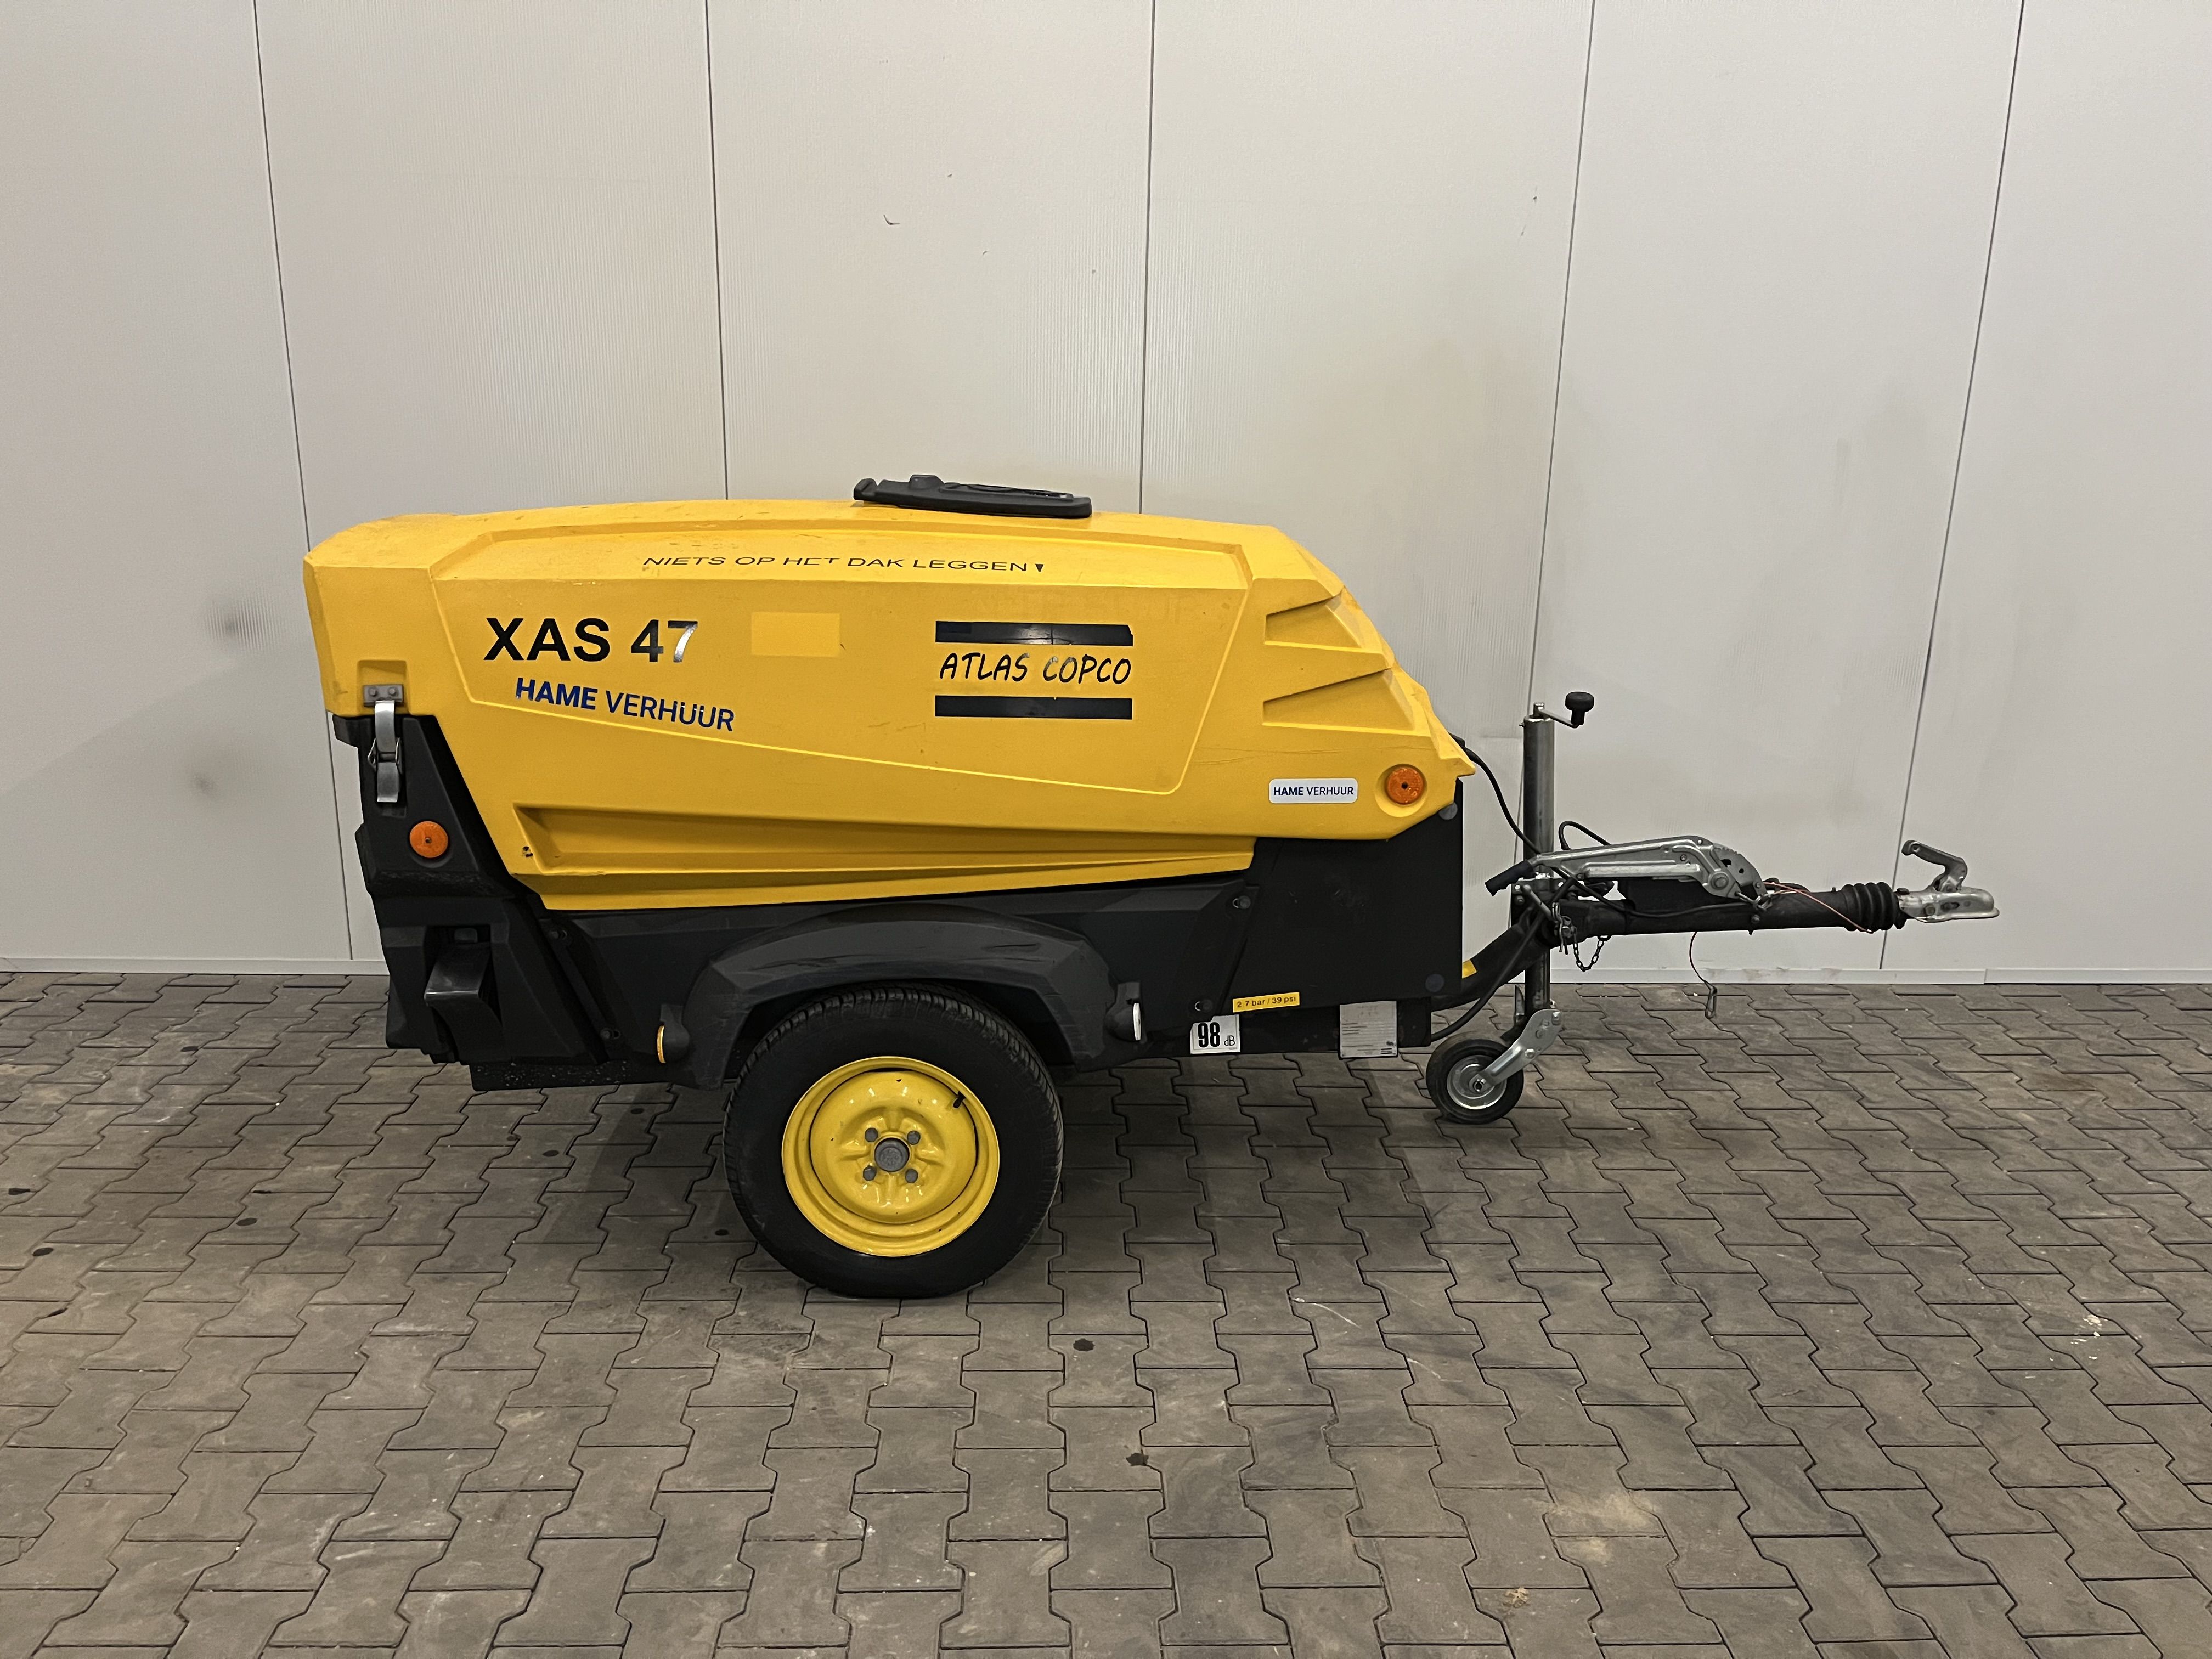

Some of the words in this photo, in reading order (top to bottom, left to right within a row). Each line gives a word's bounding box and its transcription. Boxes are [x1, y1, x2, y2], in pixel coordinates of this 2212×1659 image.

[642, 557, 726, 565] NIETS
[847, 558, 905, 567] DAK
[913, 559, 1028, 572] LEGGEN
[483, 618, 611, 662] XAS
[630, 619, 698, 663] 47
[939, 652, 1030, 682] ATLAS
[1042, 653, 1132, 684] COPCO
[516, 678, 598, 710] HAME
[1273, 787, 1304, 795] HAME
[1306, 786, 1354, 795] VERHUUR
[1198, 1022, 1221, 1048] 98
[1223, 1035, 1235, 1046] dB
